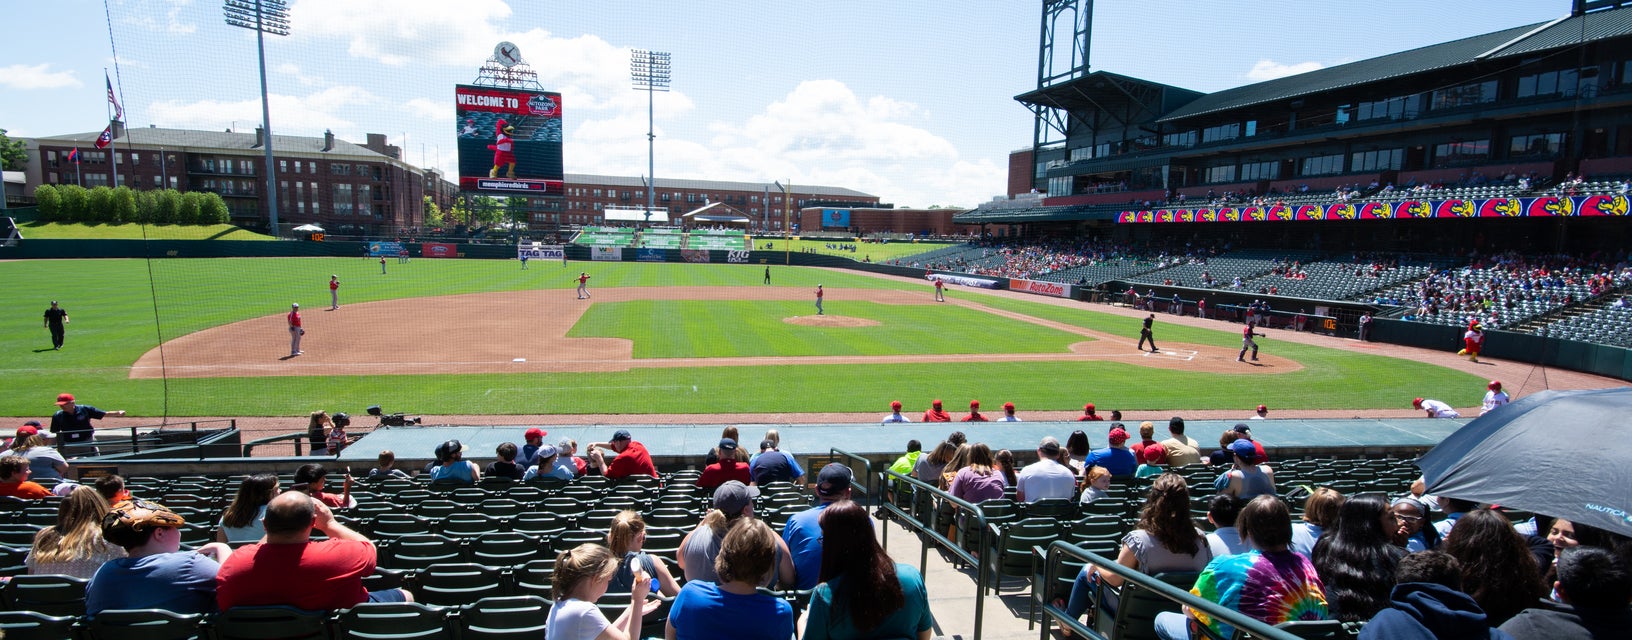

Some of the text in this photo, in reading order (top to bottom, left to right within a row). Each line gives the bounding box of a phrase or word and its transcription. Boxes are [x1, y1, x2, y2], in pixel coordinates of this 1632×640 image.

[457, 93, 519, 109] WELCOME TO
[1029, 281, 1064, 295] AutoZone
[1585, 503, 1625, 517] NAUTICA
